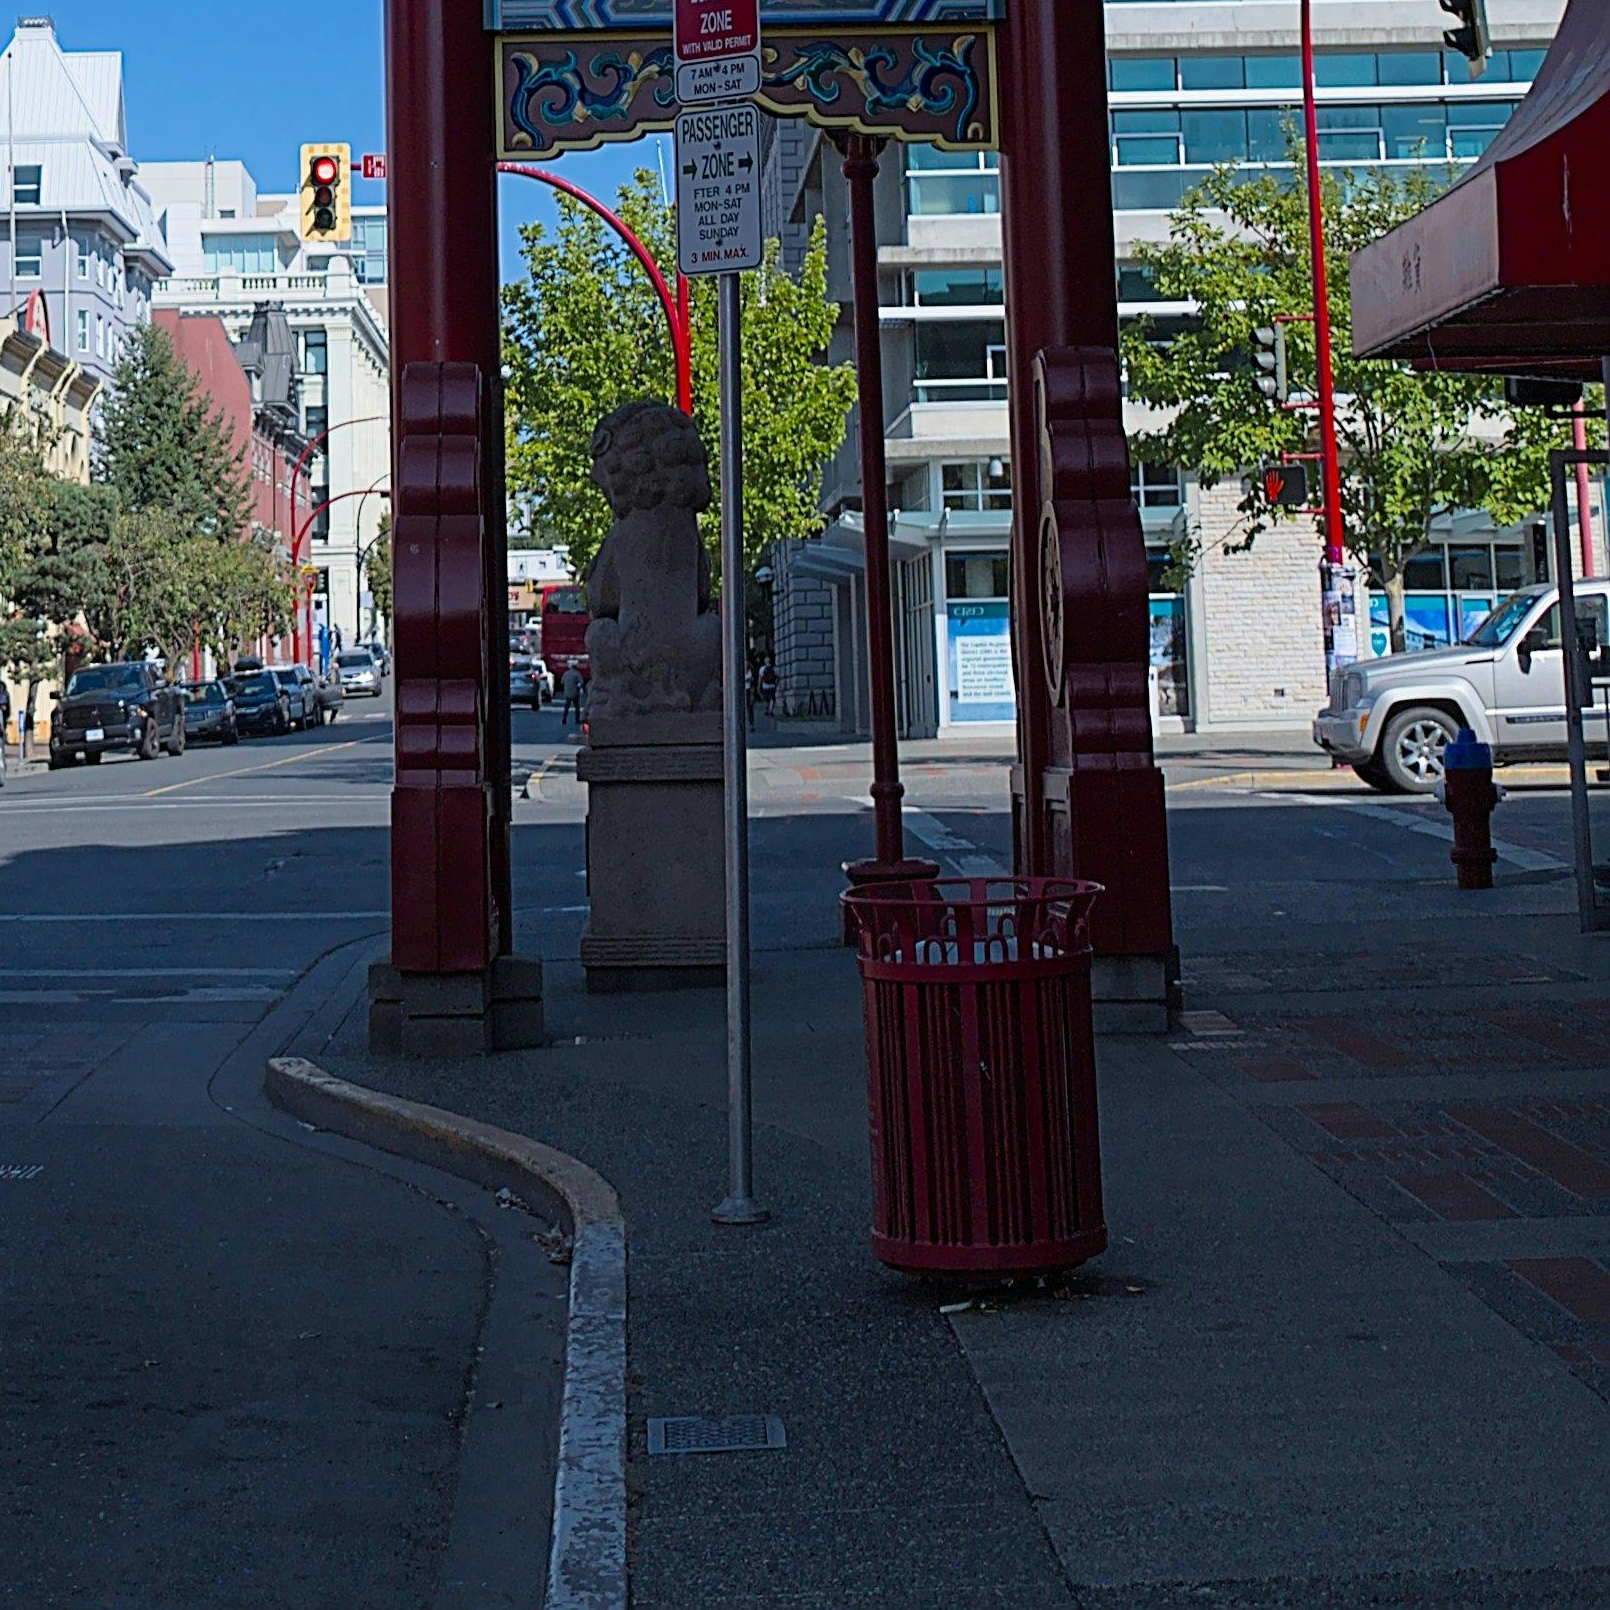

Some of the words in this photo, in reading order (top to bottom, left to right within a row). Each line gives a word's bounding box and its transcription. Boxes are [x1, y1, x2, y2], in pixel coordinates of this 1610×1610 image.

[700, 10, 732, 34] ZONE
[682, 42, 701, 55] WITH
[703, 39, 723, 52] VALID
[725, 35, 752, 50] PERMIT
[691, 69, 696, 80] 7
[697, 67, 713, 79] AM
[722, 64, 728, 75] 4
[730, 63, 745, 74] PM
[682, 112, 754, 144] PASSENGER
[701, 151, 735, 180] ZONE
[725, 185, 732, 195] 4
[735, 183, 750, 194] PM
[694, 198, 742, 212] MON-SAT
[698, 214, 716, 226] ALL
[720, 212, 740, 224] DAY
[699, 226, 740, 240] SUNDAY
[691, 252, 697, 263] 3
